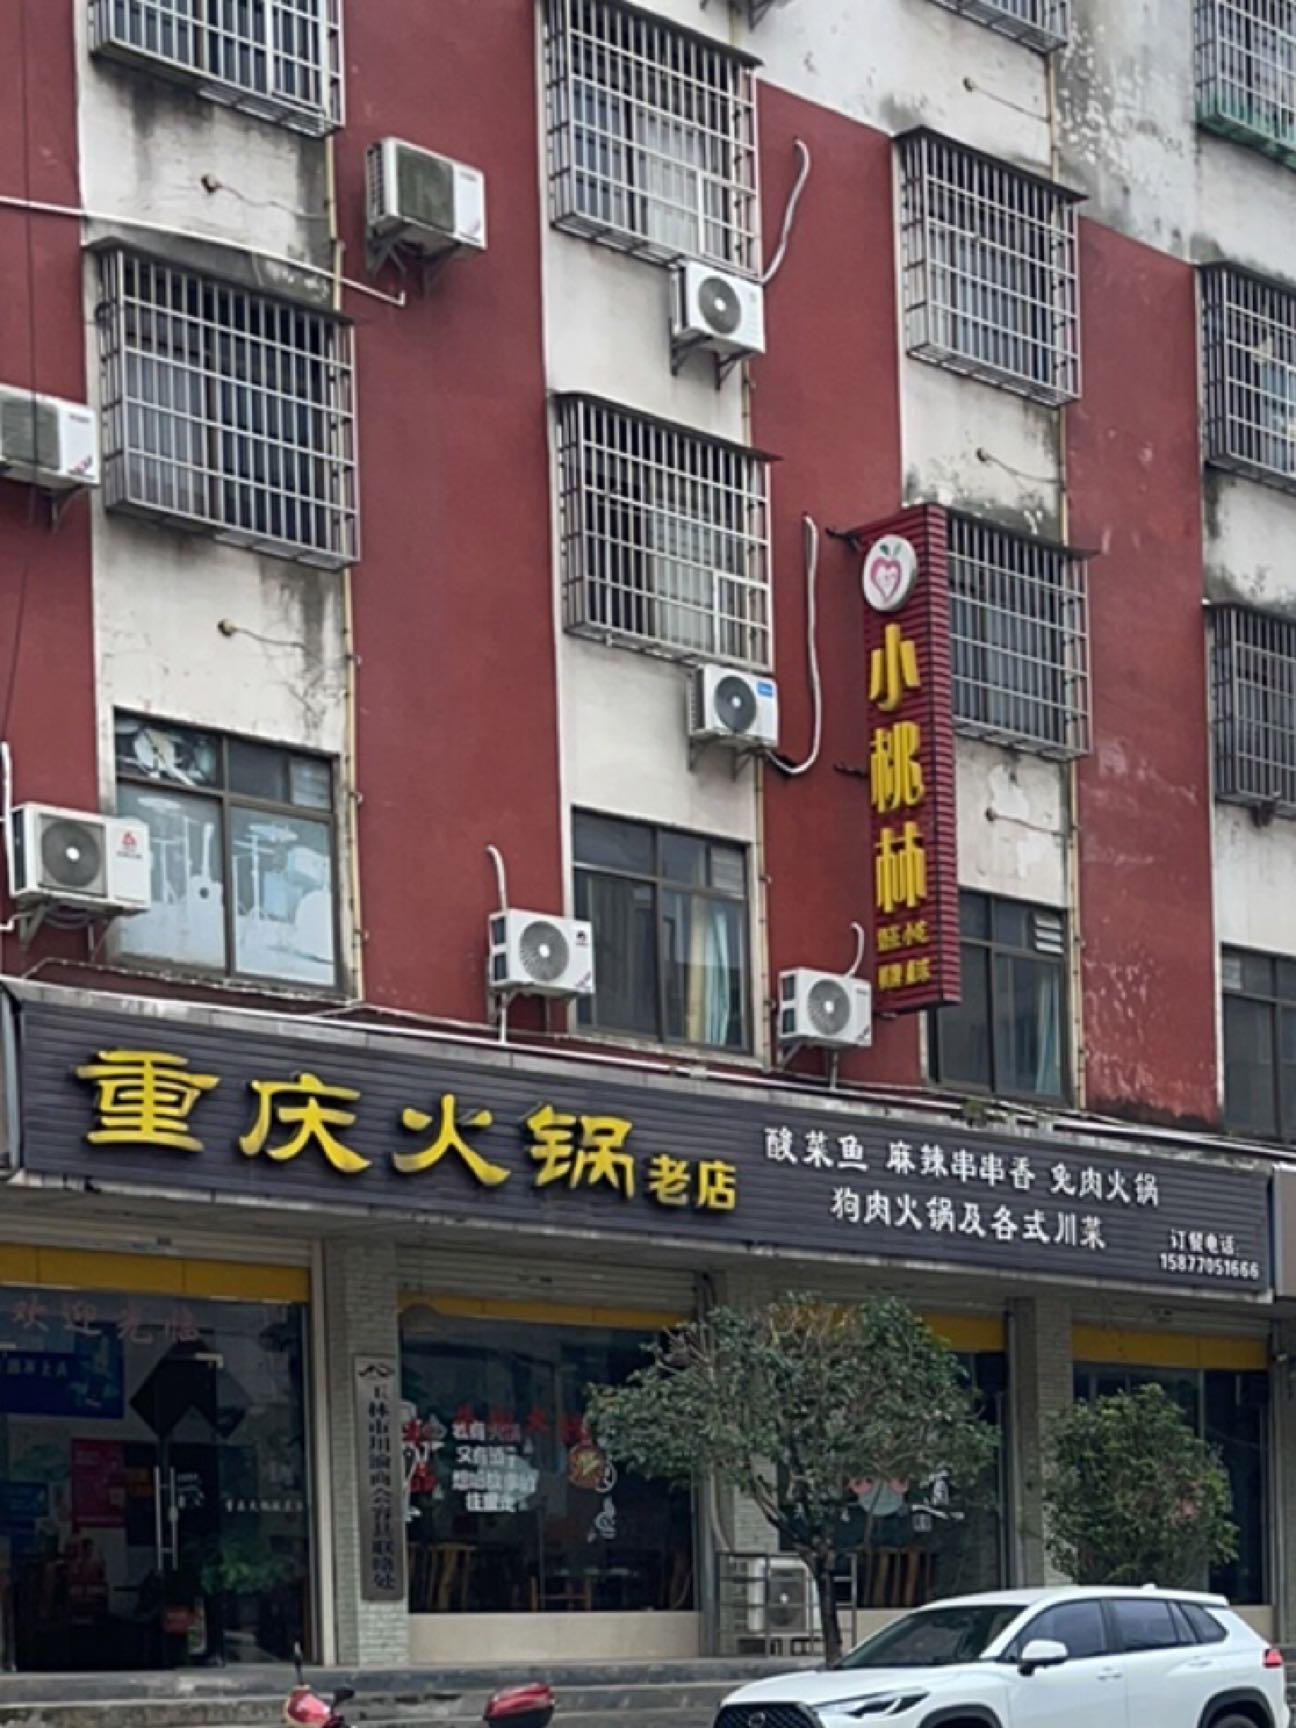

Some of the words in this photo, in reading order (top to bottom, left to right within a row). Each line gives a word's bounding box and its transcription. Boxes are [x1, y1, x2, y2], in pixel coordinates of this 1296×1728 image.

[74, 1050, 636, 1199] 重庆火锅
[647, 1153, 737, 1213] 老店
[763, 1126, 869, 1172] 酸菜鱼
[886, 1139, 1036, 1190] 麻辣串串香
[830, 1186, 1107, 1250] 狗肉火锅及各式川菜
